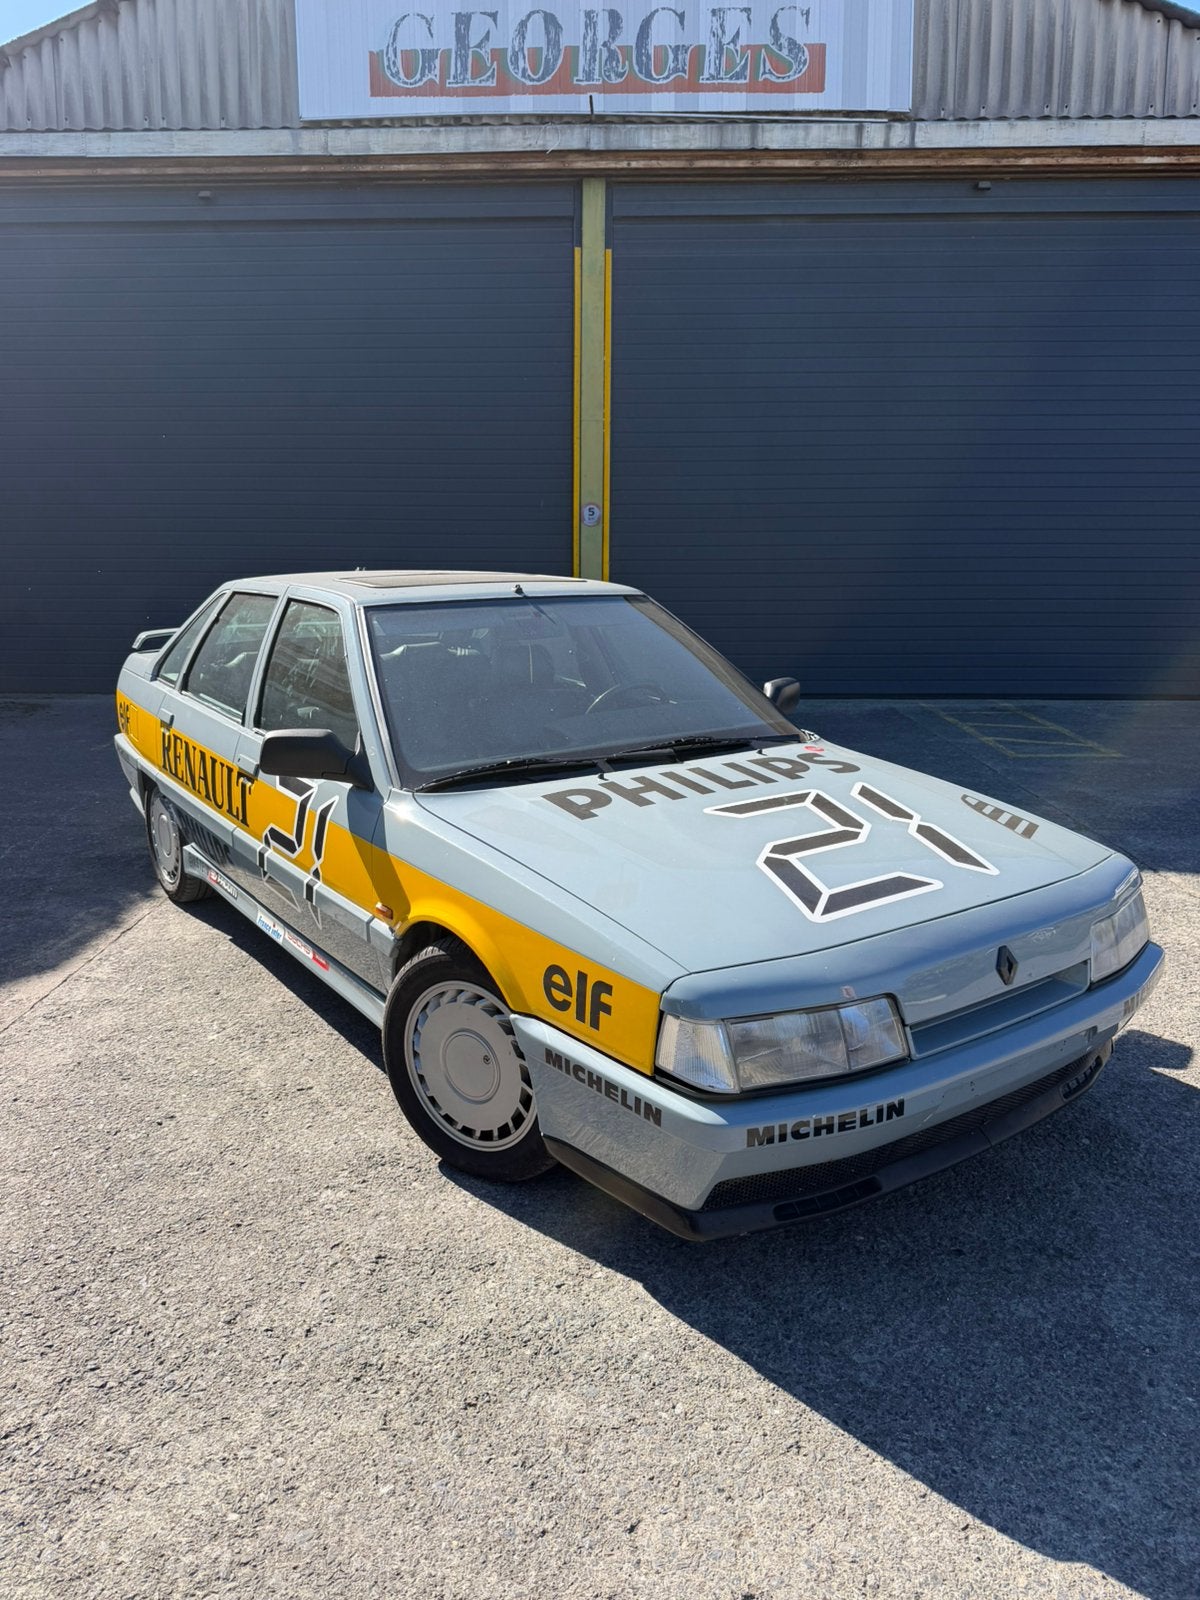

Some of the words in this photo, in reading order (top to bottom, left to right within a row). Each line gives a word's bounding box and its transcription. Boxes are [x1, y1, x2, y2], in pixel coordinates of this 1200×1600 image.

[384, 5, 811, 88] GEORGES
[588, 507, 595, 517] 5
[161, 730, 255, 828] RENAULT
[541, 752, 861, 821] PHILIPS
[702, 781, 1001, 924] 21
[543, 963, 613, 1032] elf
[544, 1047, 662, 1128] MICHELIN
[746, 1098, 905, 1148] MICHELIN
